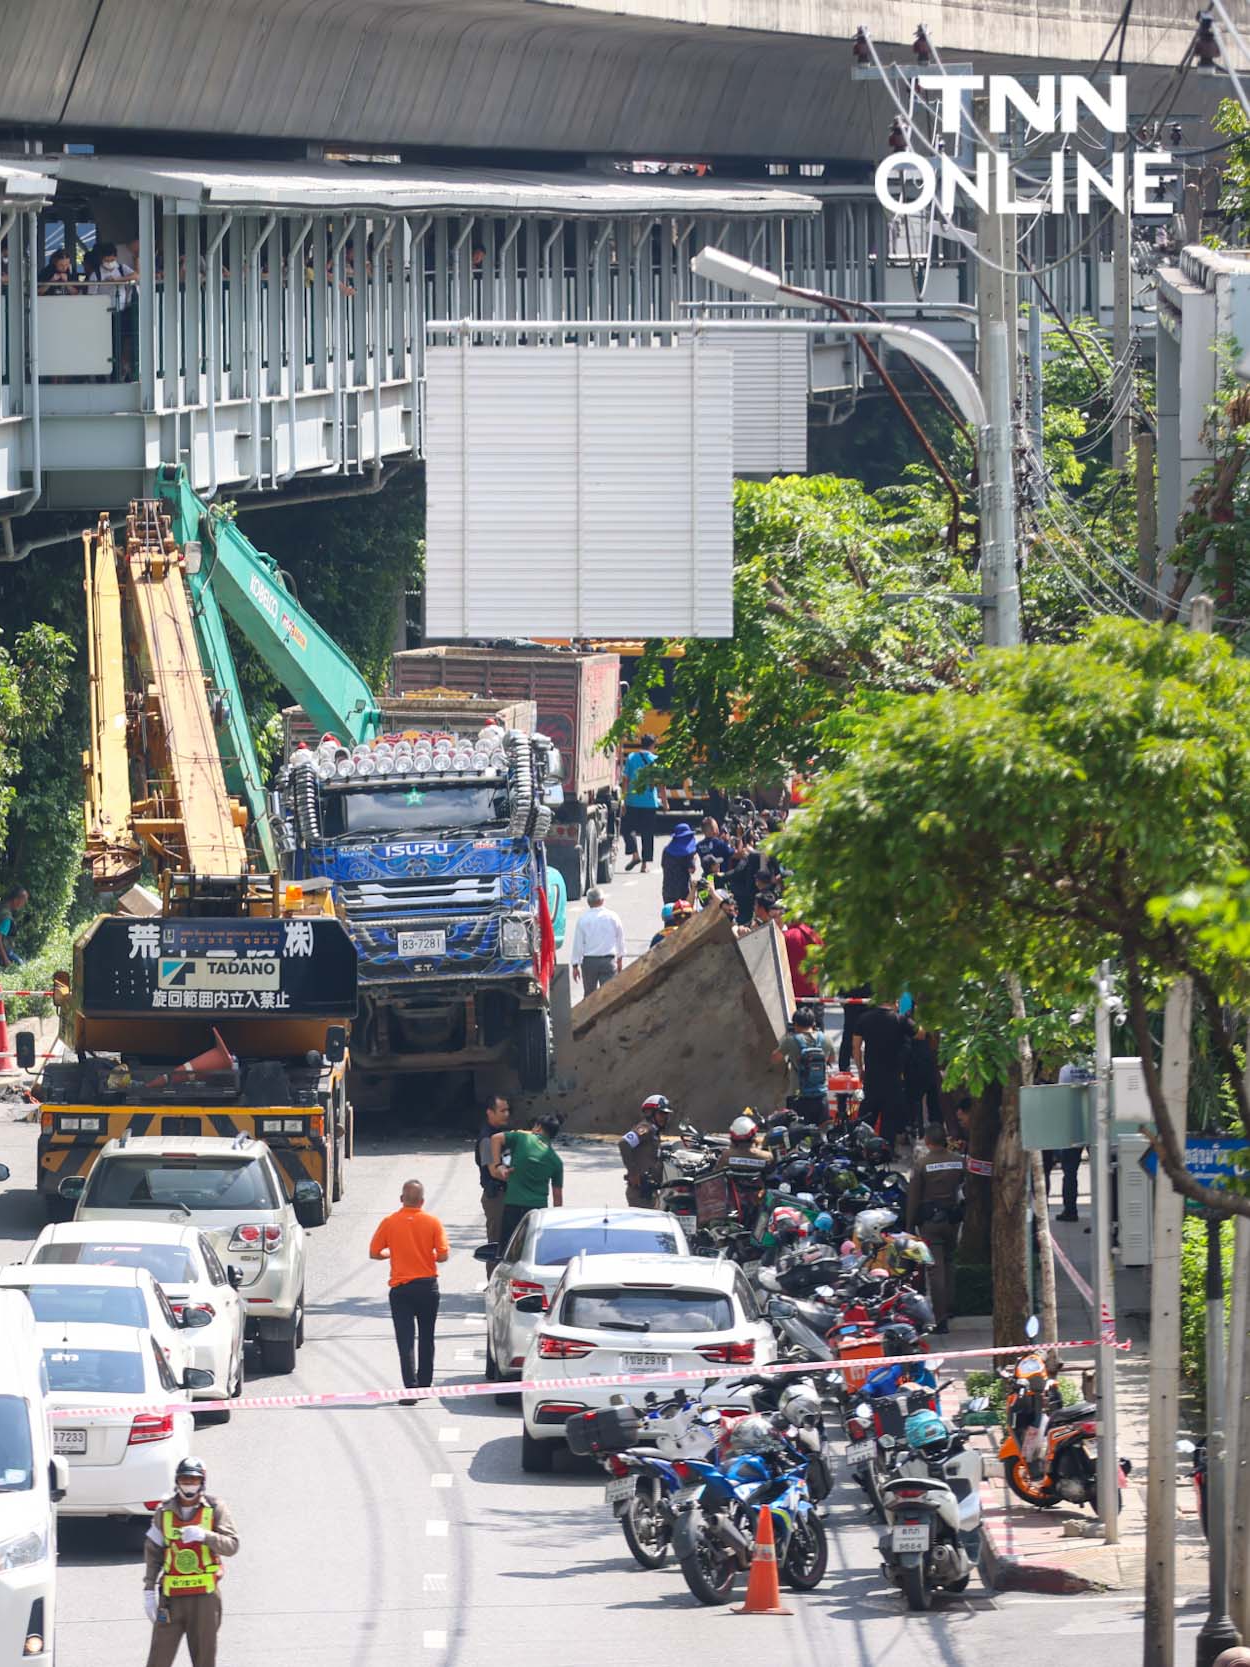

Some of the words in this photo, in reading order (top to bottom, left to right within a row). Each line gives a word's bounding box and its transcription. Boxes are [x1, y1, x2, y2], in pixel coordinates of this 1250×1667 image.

[250, 573, 278, 618] KOBELCO
[385, 843, 448, 857] ISUZU
[402, 938, 439, 950] 83-7281
[207, 962, 275, 975] TADANO
[152, 990, 290, 1009] 旋回範囲内立入禁止
[60, 1432, 83, 1442] 7233
